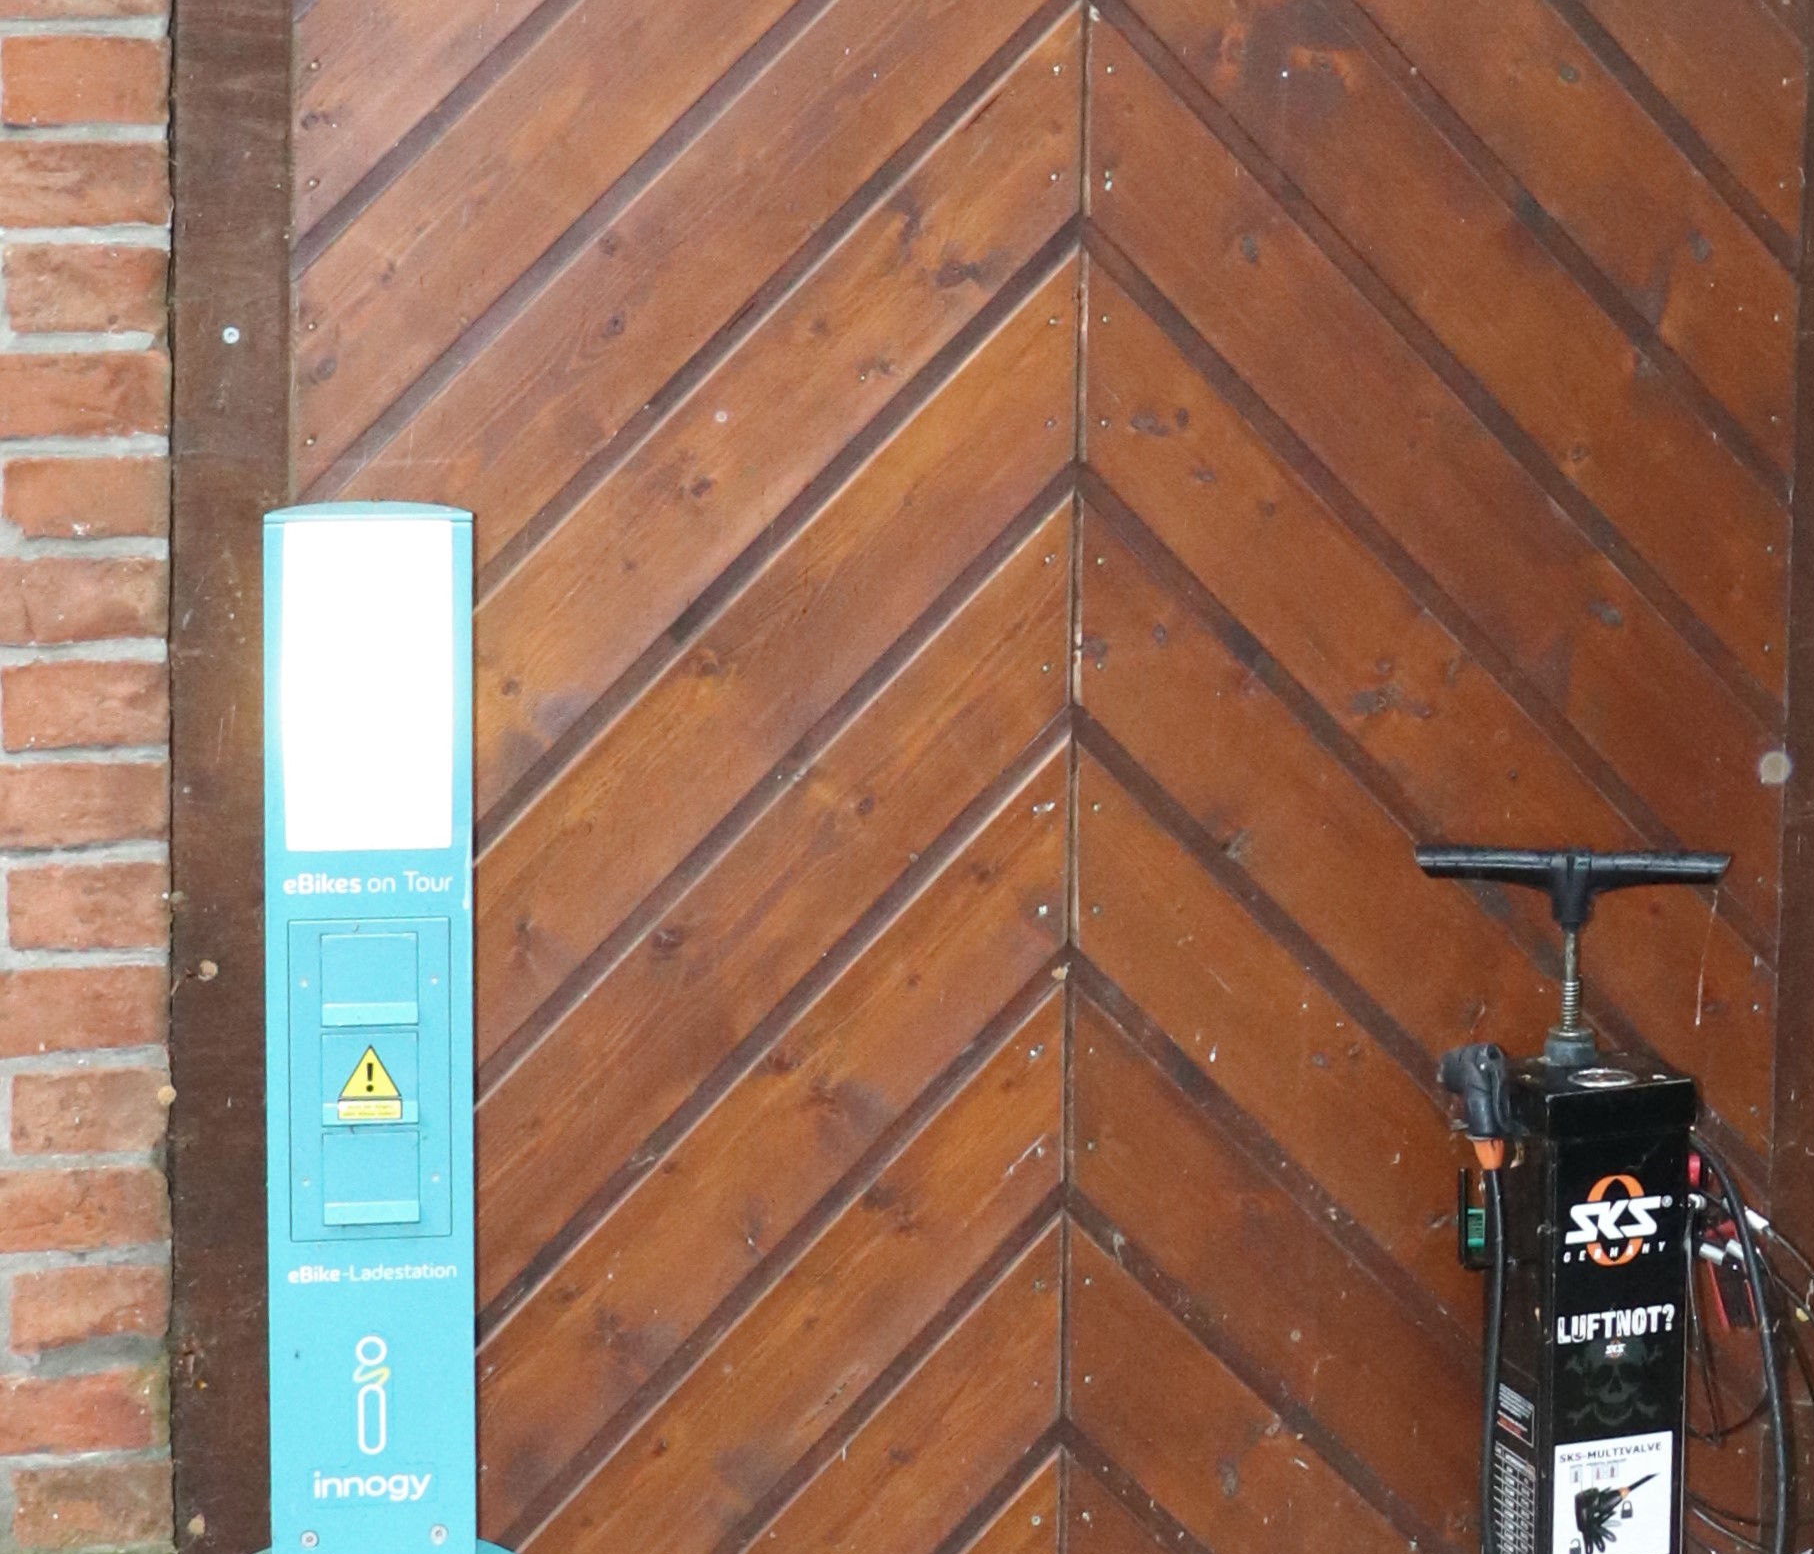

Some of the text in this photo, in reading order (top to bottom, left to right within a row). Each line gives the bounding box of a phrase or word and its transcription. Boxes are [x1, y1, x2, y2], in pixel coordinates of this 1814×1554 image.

[283, 870, 453, 894] eBikes on Tour
[1563, 1241, 1666, 1263] GERMANY
[288, 1263, 457, 1284] eBike-Ladestation
[1557, 1304, 1675, 1344] LUFTNOT?
[1559, 1442, 1661, 1463] SKS-MULTIVALVE
[314, 1471, 431, 1500] innogy
